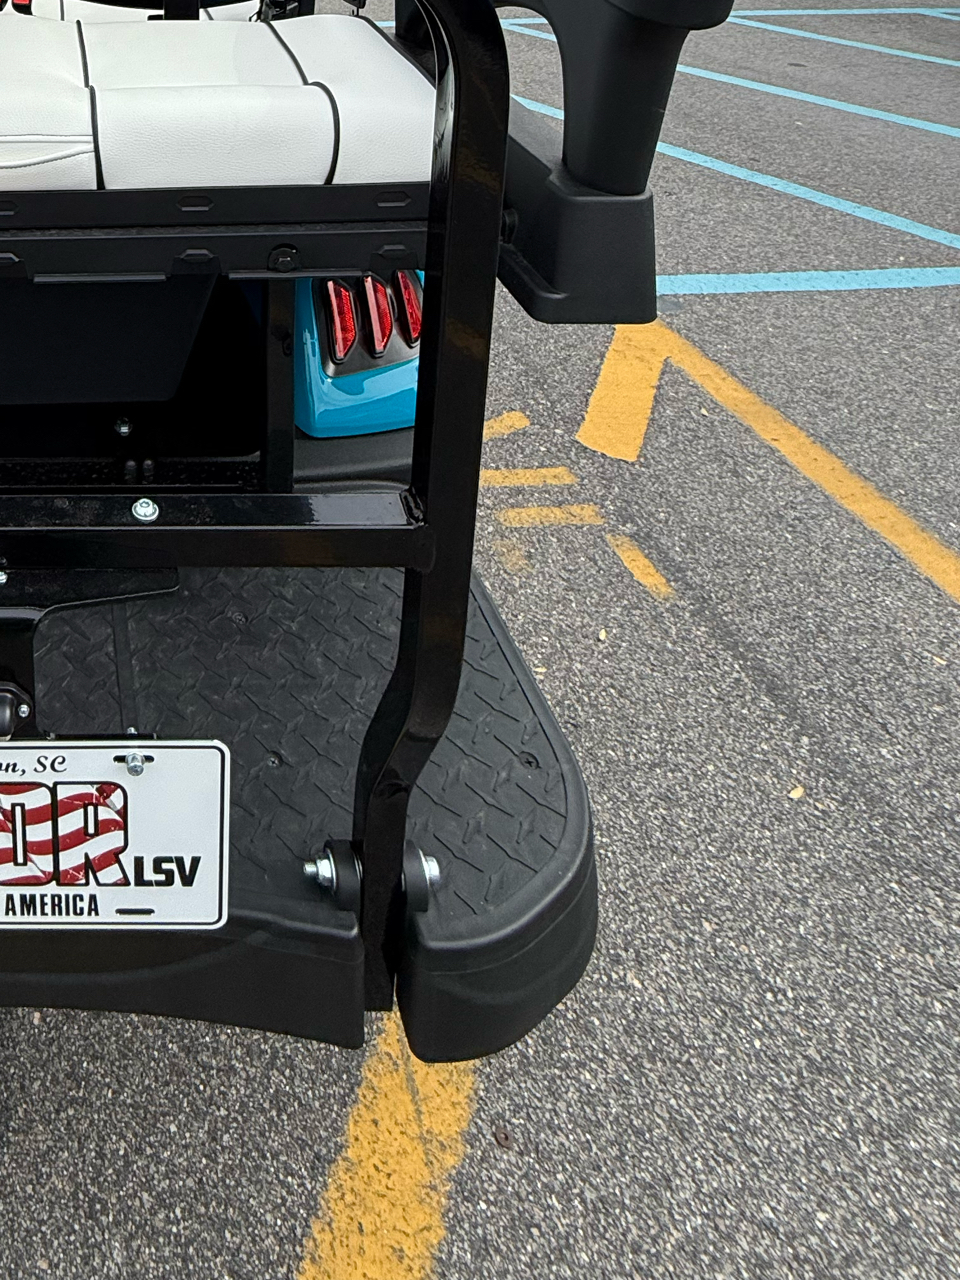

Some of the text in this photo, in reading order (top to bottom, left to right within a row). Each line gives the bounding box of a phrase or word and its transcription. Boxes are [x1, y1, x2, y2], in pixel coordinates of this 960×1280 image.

[33, 755, 67, 773] SC
[133, 855, 203, 888] LSV
[4, 893, 100, 917] AMERICA
